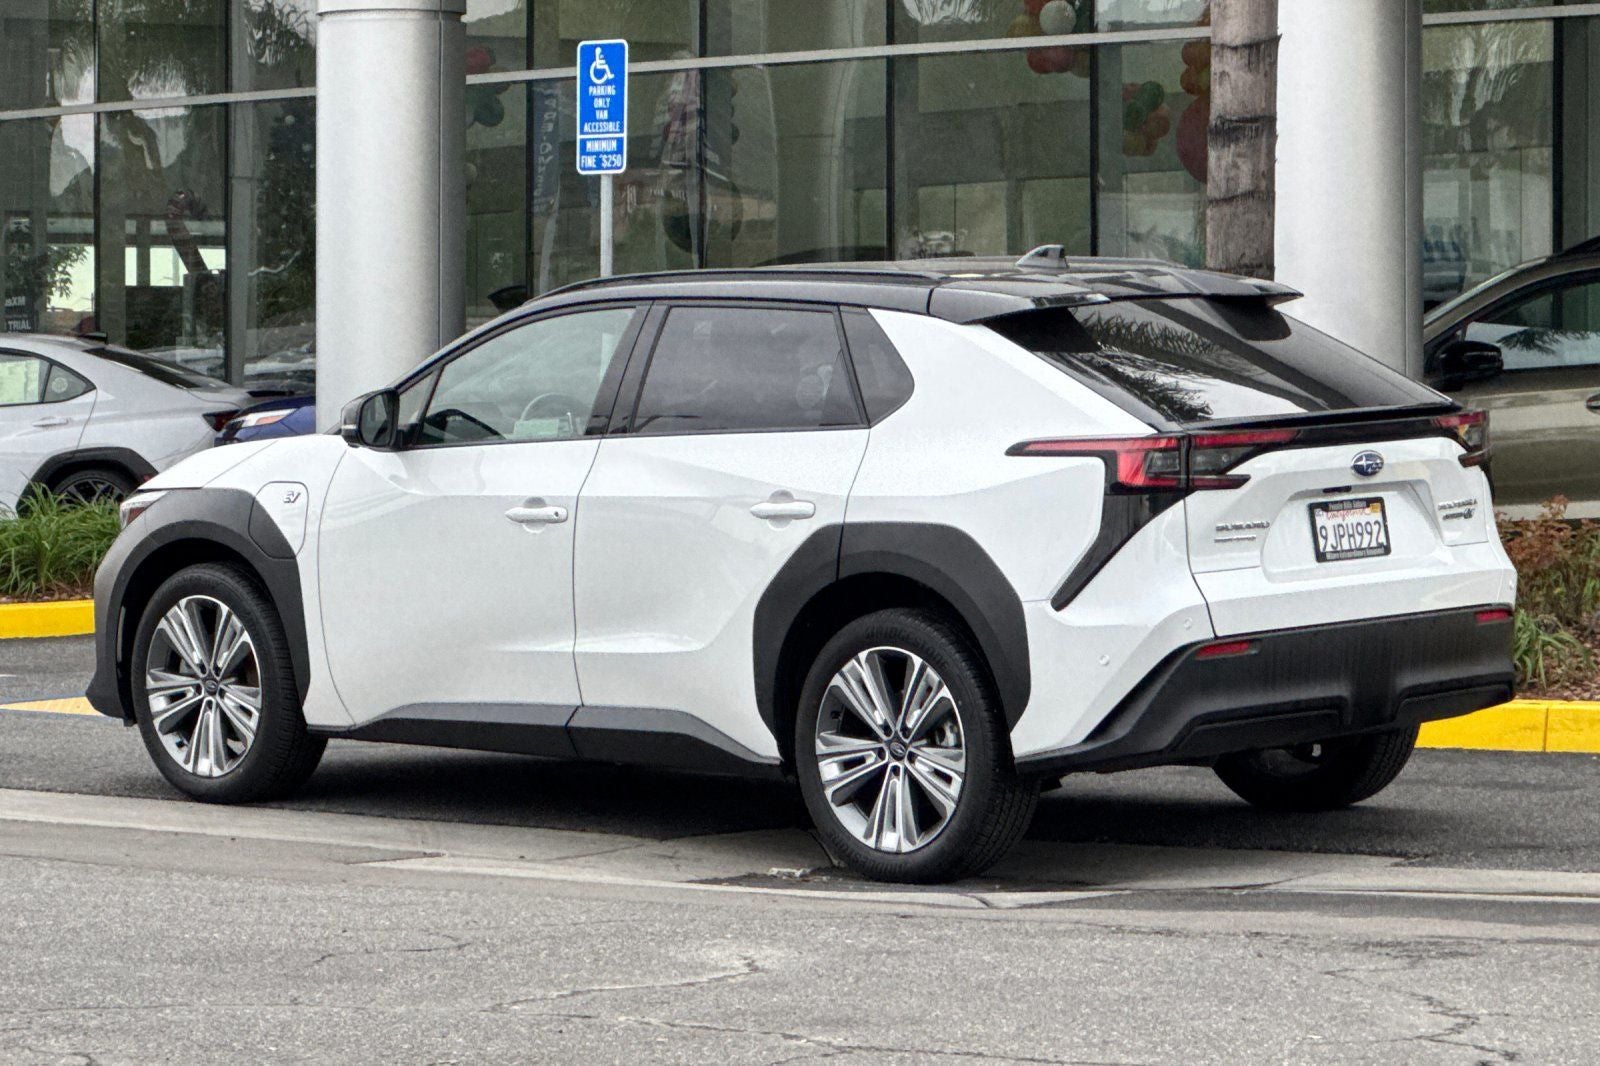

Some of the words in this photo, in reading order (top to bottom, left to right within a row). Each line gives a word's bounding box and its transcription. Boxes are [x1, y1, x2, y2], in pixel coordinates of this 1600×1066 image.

[588, 85, 616, 96] PARKING
[593, 97, 611, 109] ONLY
[595, 109, 609, 120] VAN
[583, 121, 620, 133] ACCESSIBLE
[586, 139, 617, 152] MINIMUM
[581, 154, 597, 168] FINE
[600, 153, 622, 168] $250
[1319, 519, 1384, 553] 9JPH992
